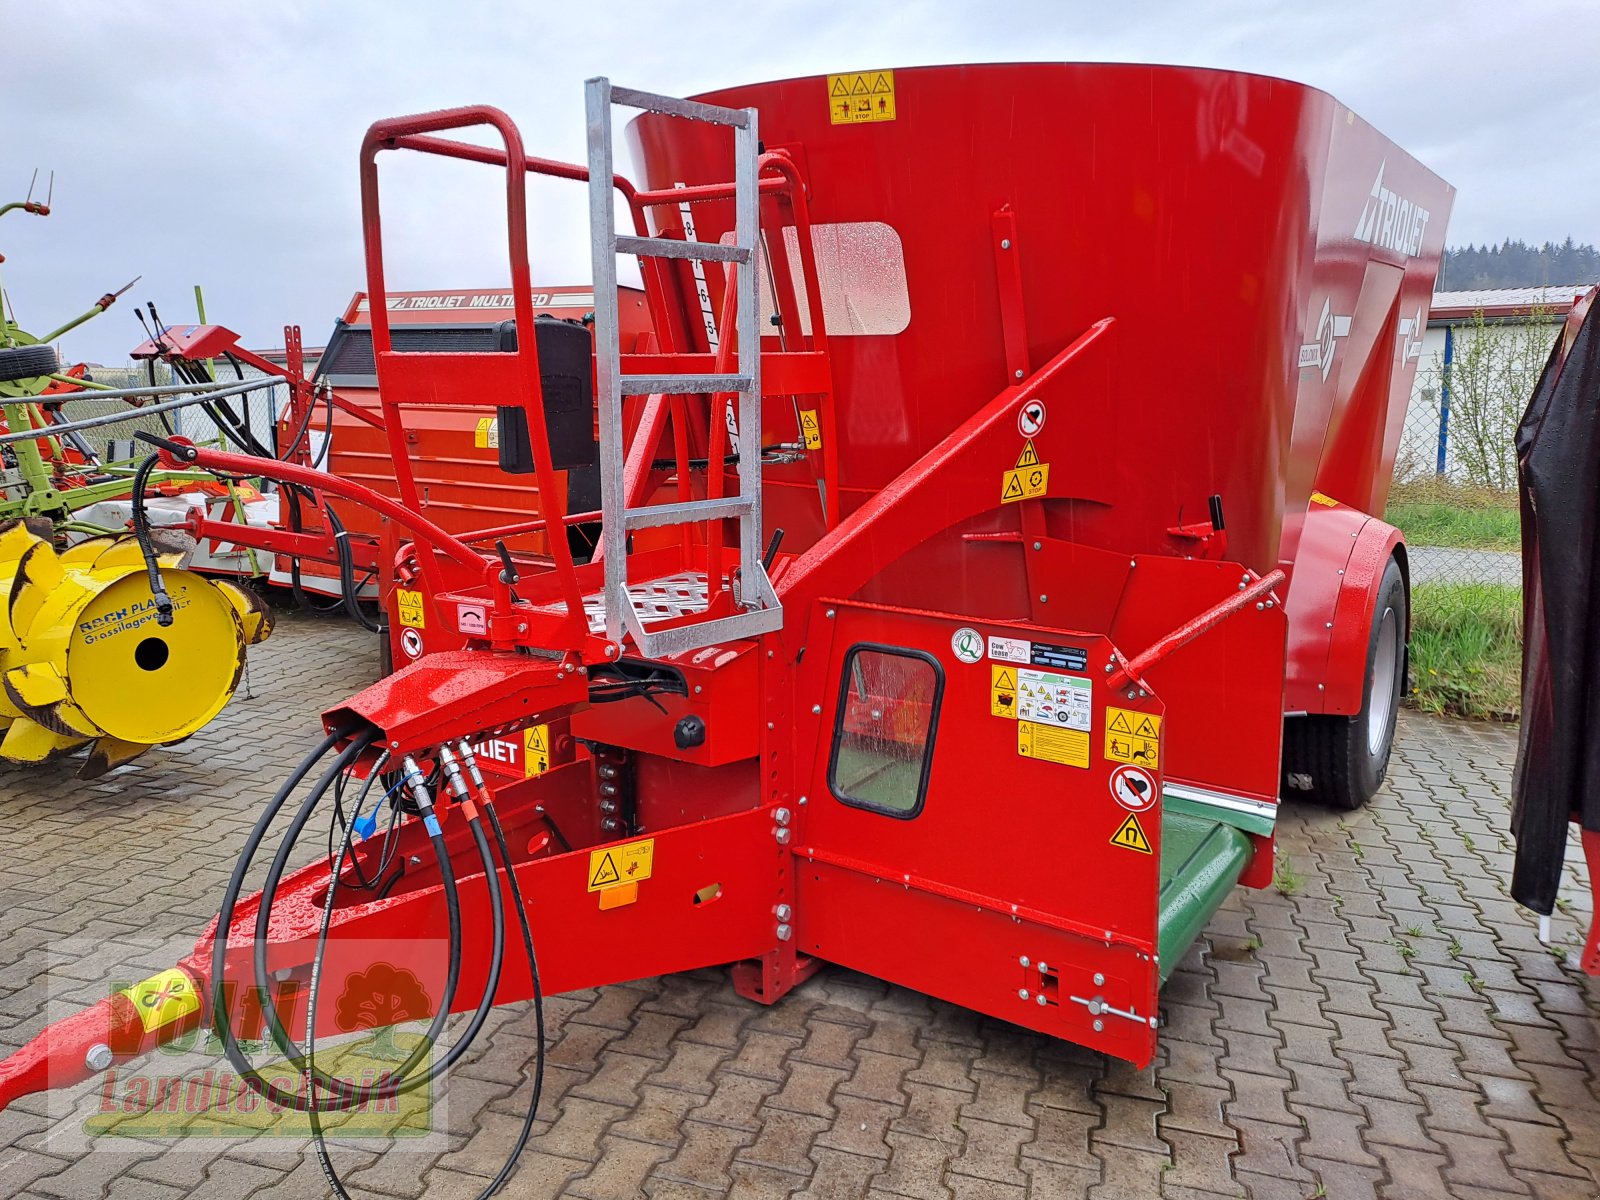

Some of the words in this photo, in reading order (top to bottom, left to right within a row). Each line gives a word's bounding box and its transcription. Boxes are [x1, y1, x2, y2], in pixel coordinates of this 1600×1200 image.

[685, 221, 693, 236] 8
[1373, 186, 1430, 258] TRIOLIET
[410, 296, 466, 308] TRIOLIET
[700, 289, 707, 303] 6
[707, 321, 714, 335] 5
[727, 413, 734, 426] 2
[1028, 486, 1042, 495] STOP
[991, 642, 1004, 650] Cow
[991, 649, 1009, 657] Lease
